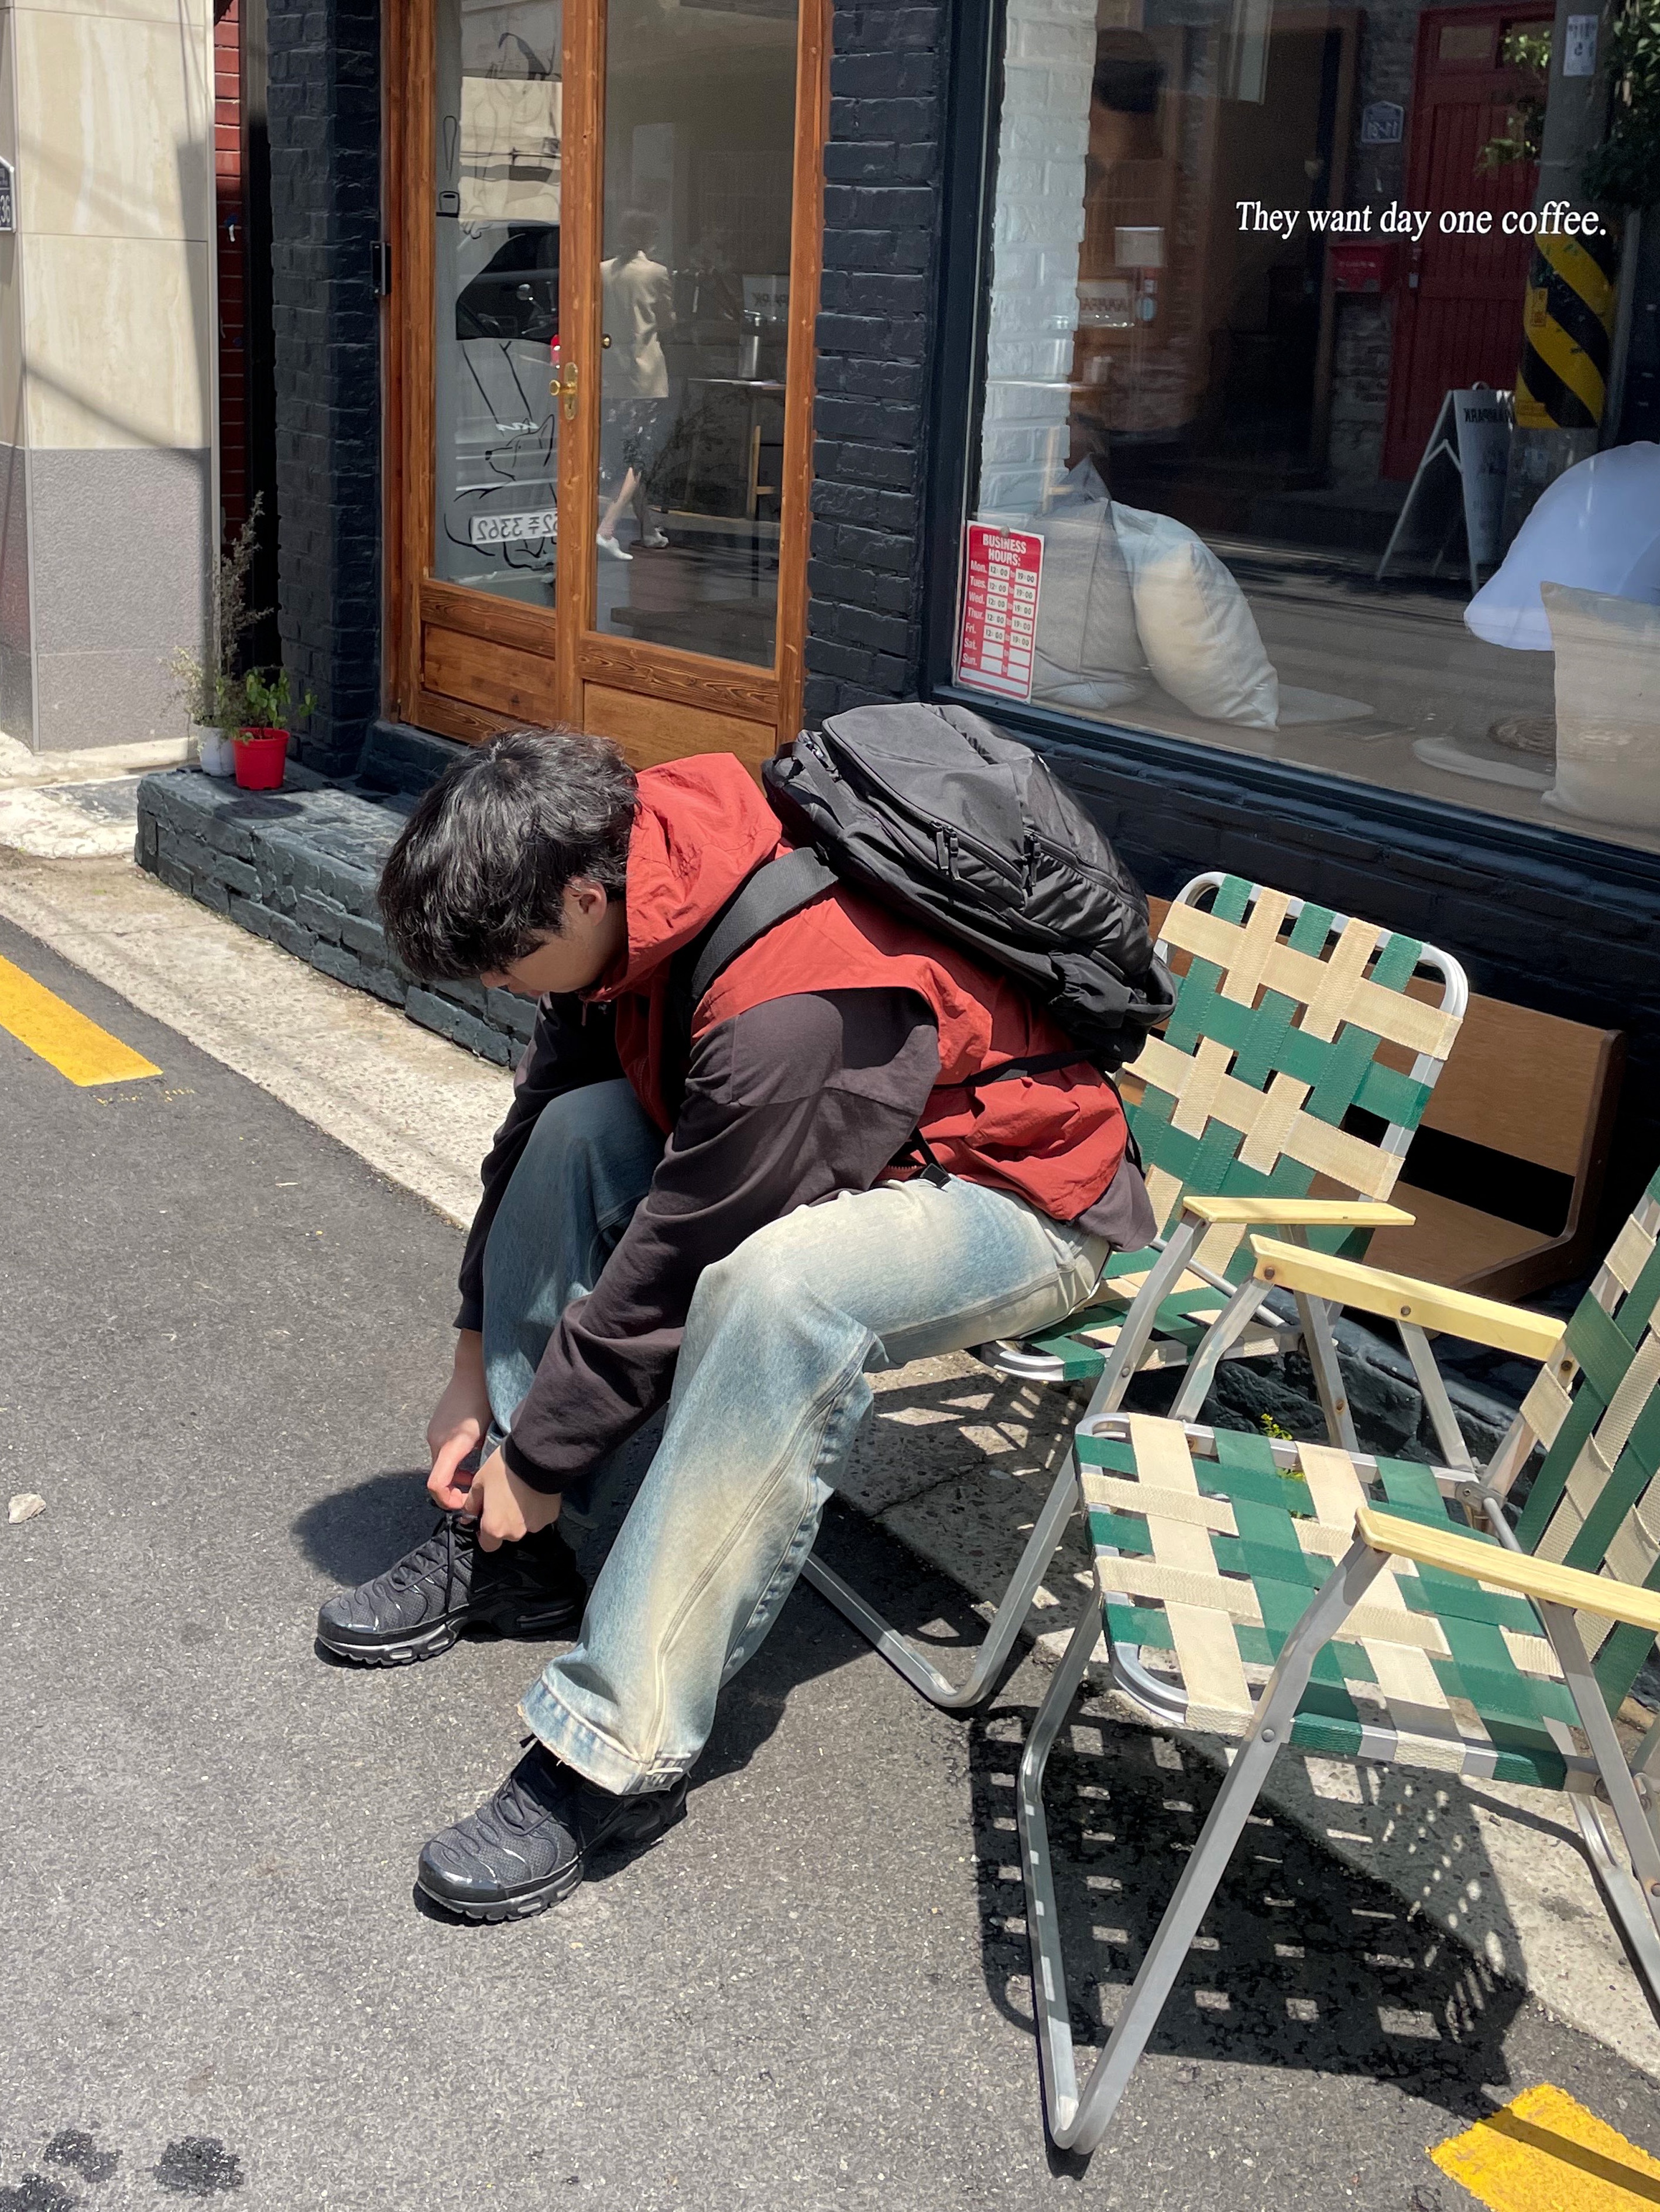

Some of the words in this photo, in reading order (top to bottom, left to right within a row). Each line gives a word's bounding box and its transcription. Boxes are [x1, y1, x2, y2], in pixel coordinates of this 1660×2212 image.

[1236, 201, 1300, 239] They
[1307, 205, 1373, 232] want
[1380, 201, 1432, 242] day
[1439, 211, 1493, 234] one
[1502, 201, 1606, 235] coffee.
[983, 533, 1027, 554] BUSINESS
[988, 548, 1021, 566] HOURS:
